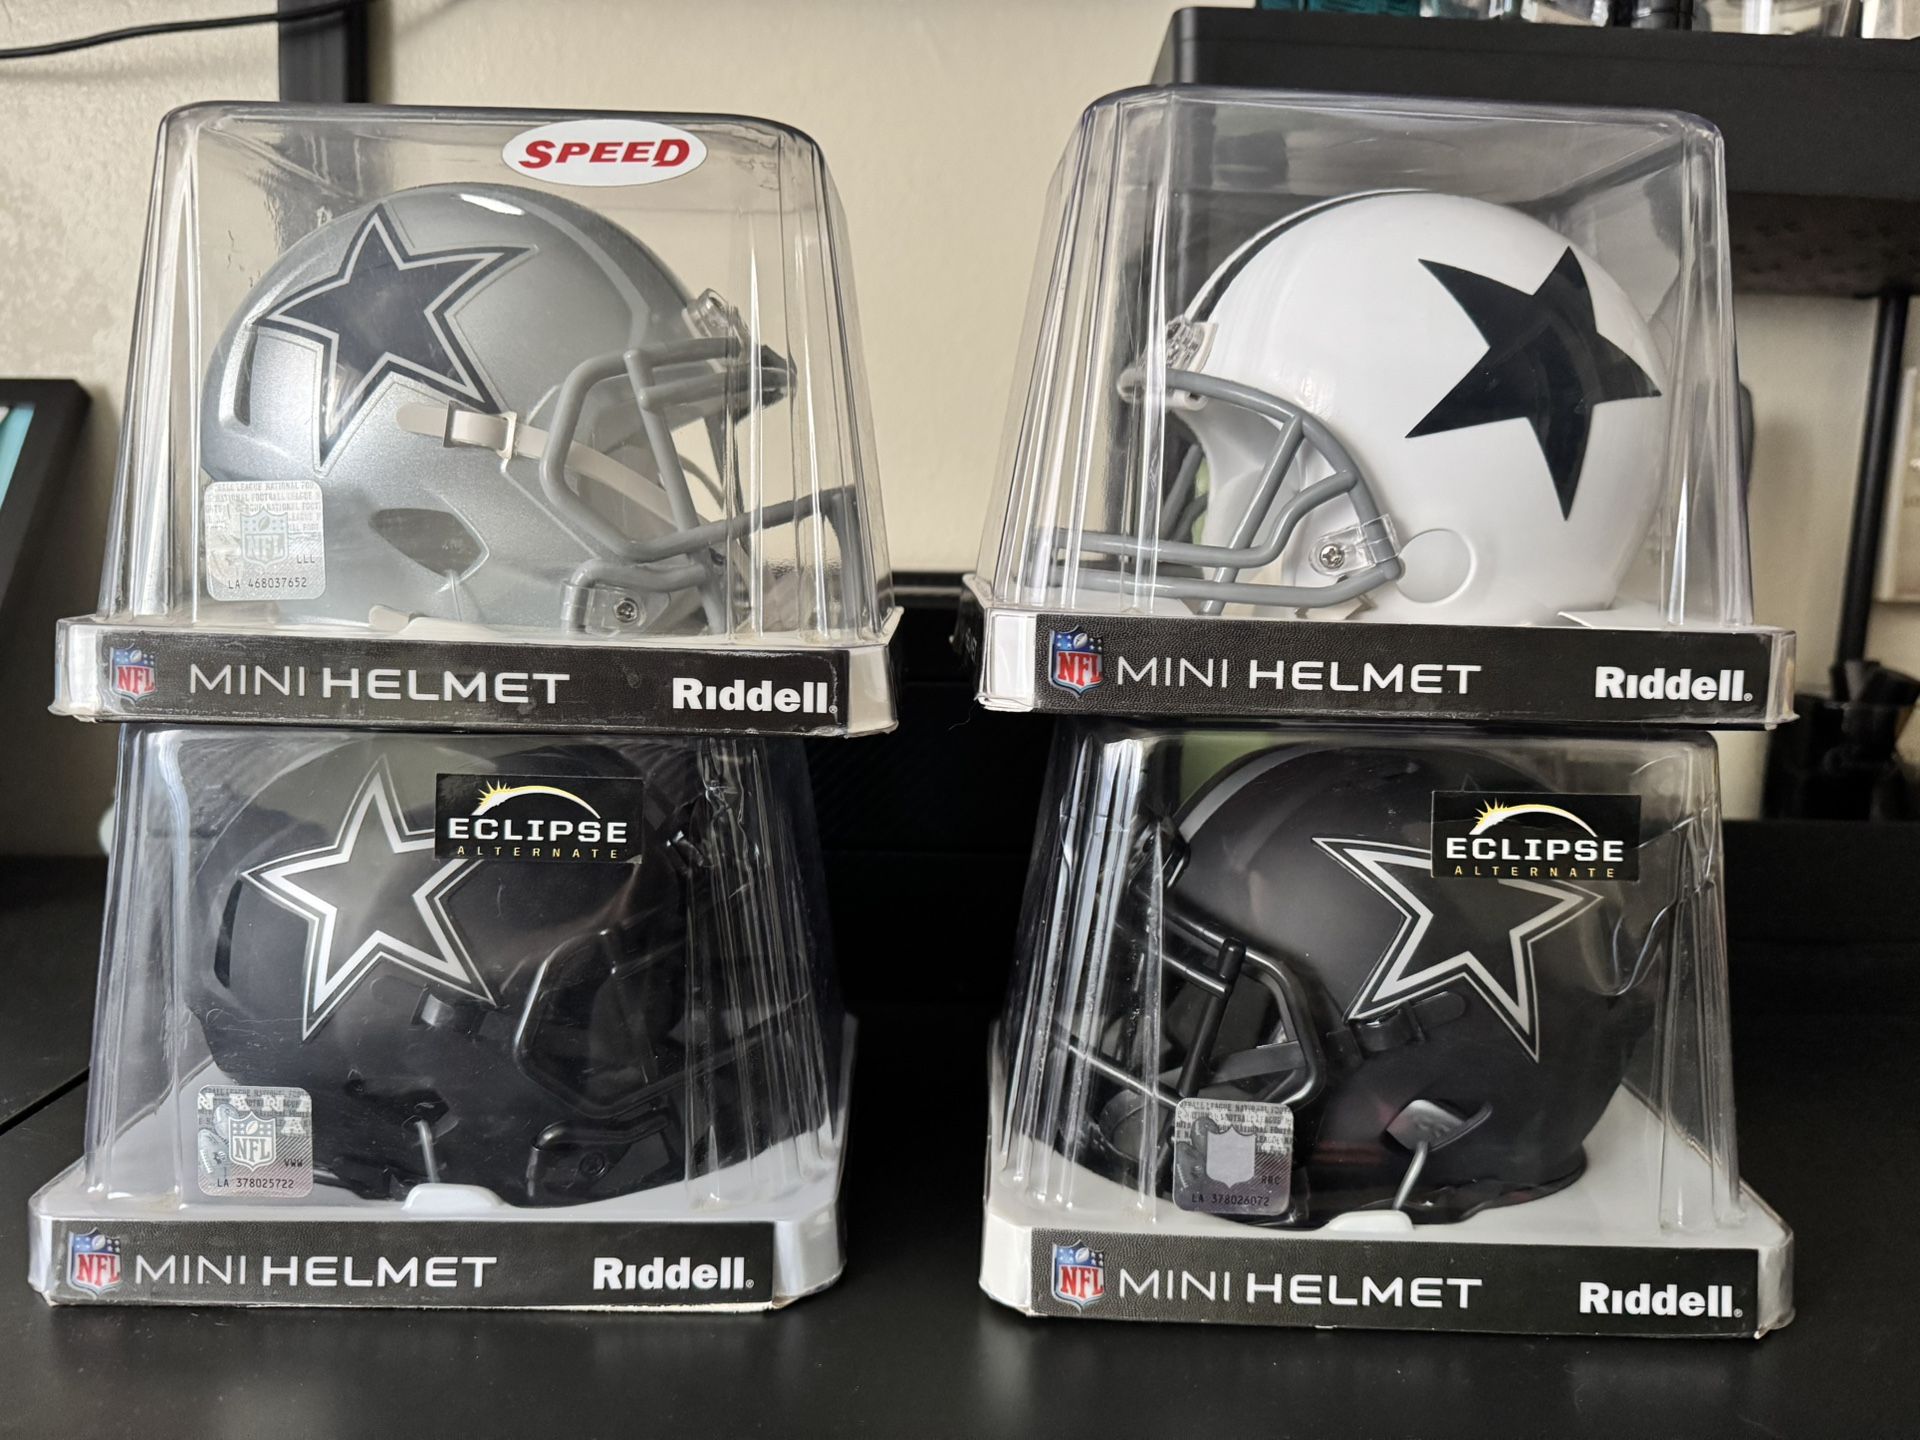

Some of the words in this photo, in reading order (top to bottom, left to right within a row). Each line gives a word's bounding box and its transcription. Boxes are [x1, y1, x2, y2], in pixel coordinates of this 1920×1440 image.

[518, 139, 690, 169] SPEED
[245, 534, 286, 561] NFL
[296, 554, 316, 564] LLL
[228, 579, 241, 590] LA
[248, 577, 308, 589] 468037652
[117, 666, 155, 695] NFL
[189, 663, 305, 696] MINI
[322, 667, 570, 704] HELMET
[1057, 651, 1103, 687] NFL
[1117, 656, 1227, 688] MINI
[1248, 659, 1482, 695] HELMET
[1594, 666, 1745, 702] Riddell
[672, 677, 828, 714] Riddell
[448, 817, 628, 843] ECLIPSE
[457, 846, 618, 859] ALTERNATE
[1446, 837, 1624, 862] ECLIPSE
[1454, 865, 1615, 878] ALTERNATE
[235, 1137, 271, 1163] NFL
[217, 1179, 229, 1188] LA
[236, 1177, 295, 1189] 378025722
[1192, 1193, 1204, 1203] LA
[1212, 1193, 1271, 1207] 378026072
[76, 1253, 120, 1288] NFL
[135, 1254, 246, 1285] MINI
[262, 1256, 498, 1288] HELMET
[592, 1256, 745, 1290] Riddell
[1060, 1265, 1105, 1299] NFL
[1119, 1269, 1230, 1301] MINI
[1246, 1272, 1483, 1309] HELMET
[1579, 1281, 1733, 1318] Riddell
